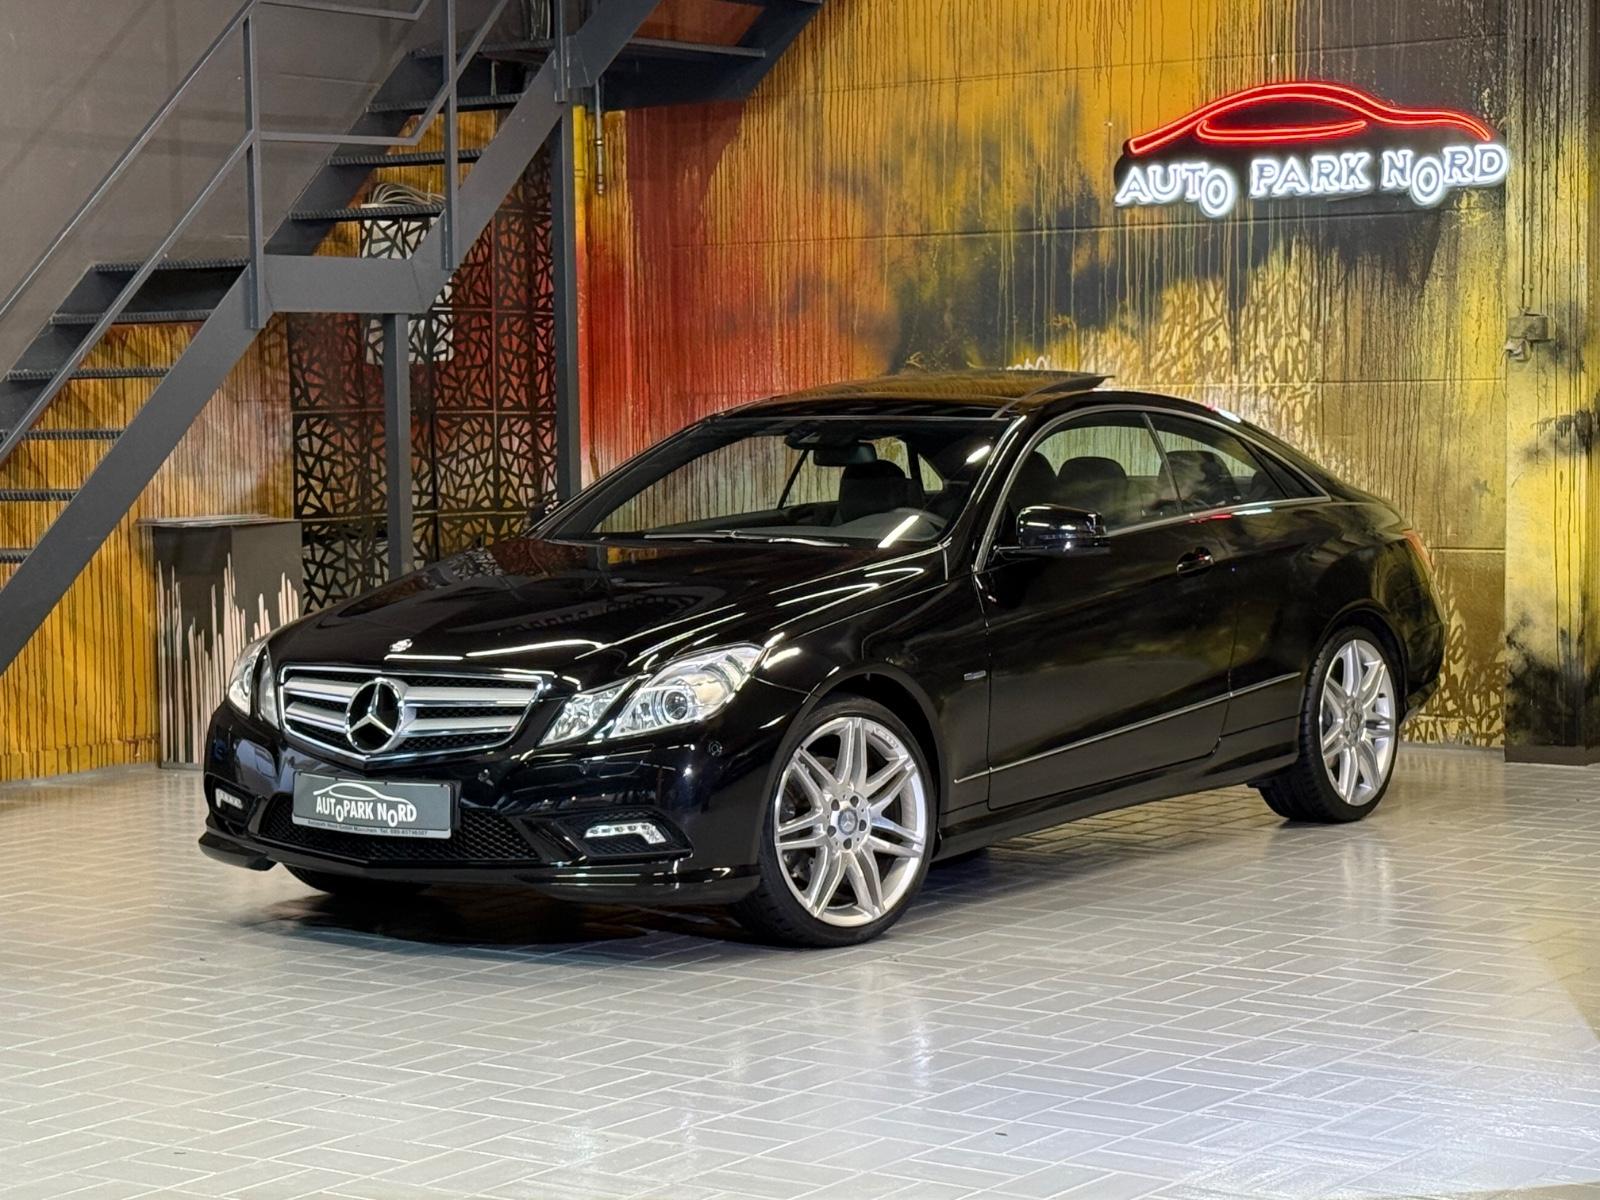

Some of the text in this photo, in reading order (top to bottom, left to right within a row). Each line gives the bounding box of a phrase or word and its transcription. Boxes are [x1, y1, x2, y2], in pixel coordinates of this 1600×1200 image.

[1115, 144, 1509, 218] AUTO PARK NORD
[316, 797, 374, 822] AUTOPARK
[377, 803, 417, 827] NORD
